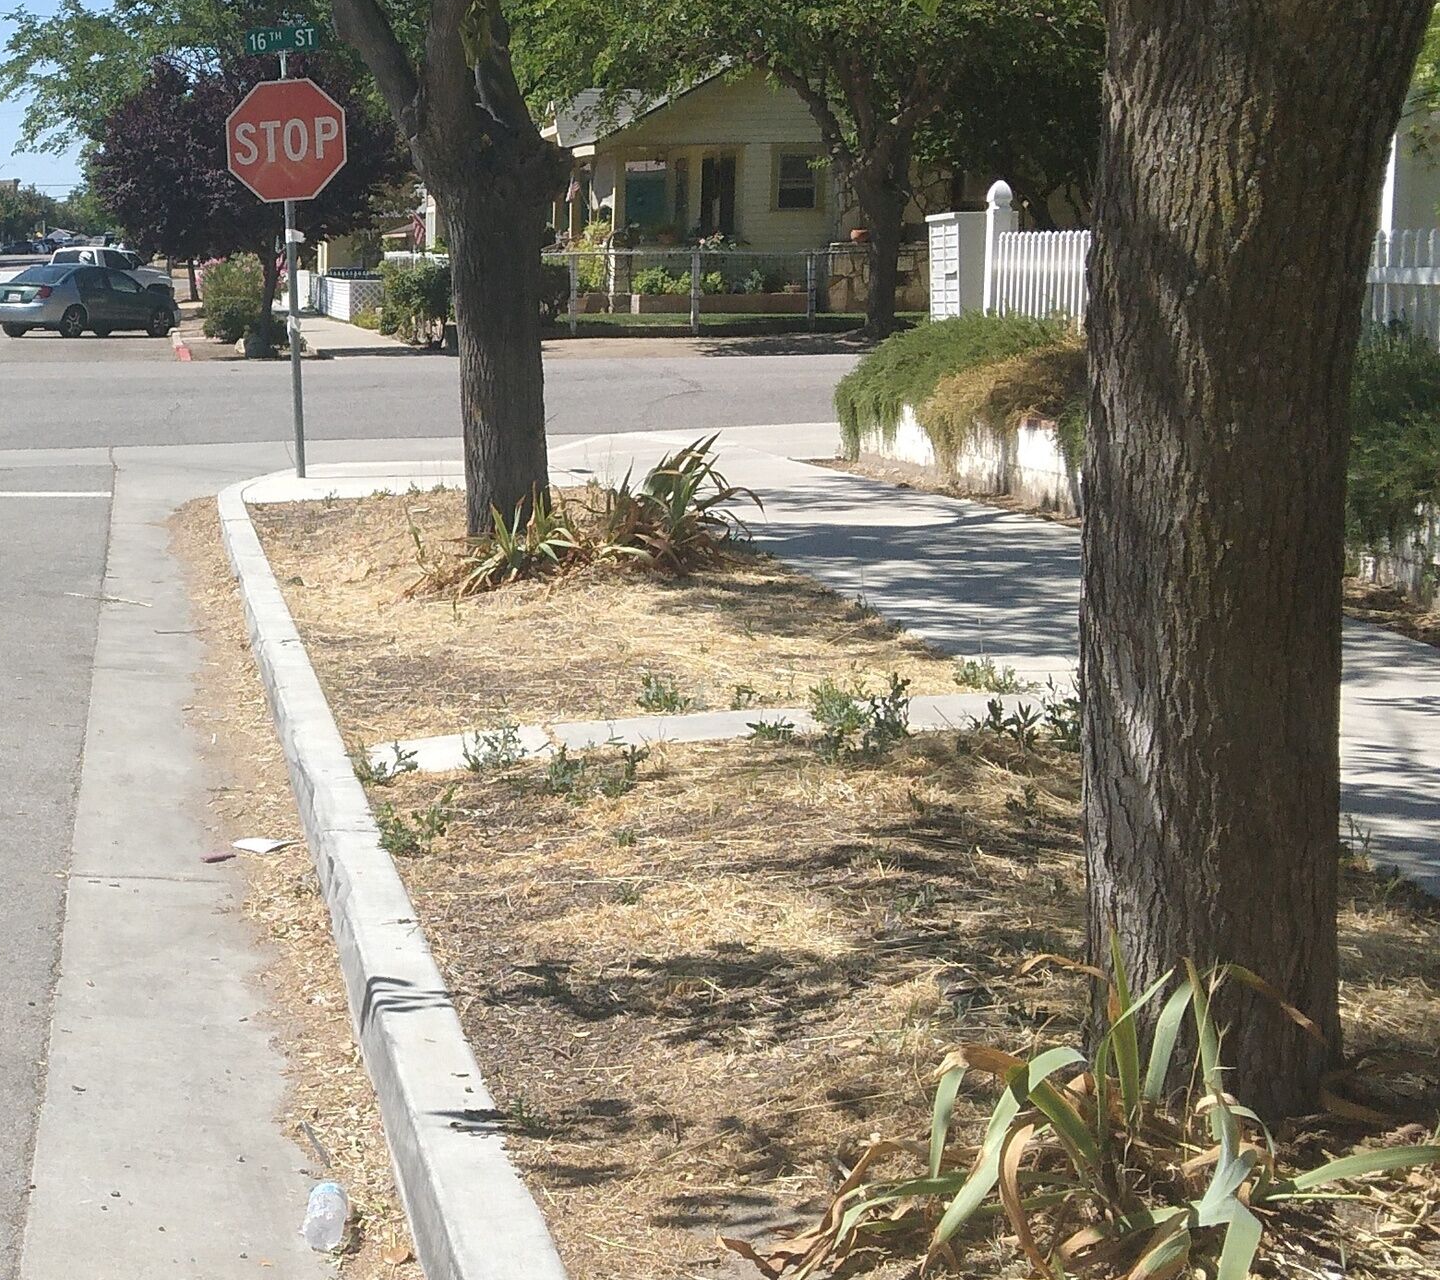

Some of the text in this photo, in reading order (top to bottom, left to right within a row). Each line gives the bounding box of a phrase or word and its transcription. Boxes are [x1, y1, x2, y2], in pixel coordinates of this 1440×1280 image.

[249, 28, 315, 51] 16TH ST
[234, 116, 339, 165] STOP
